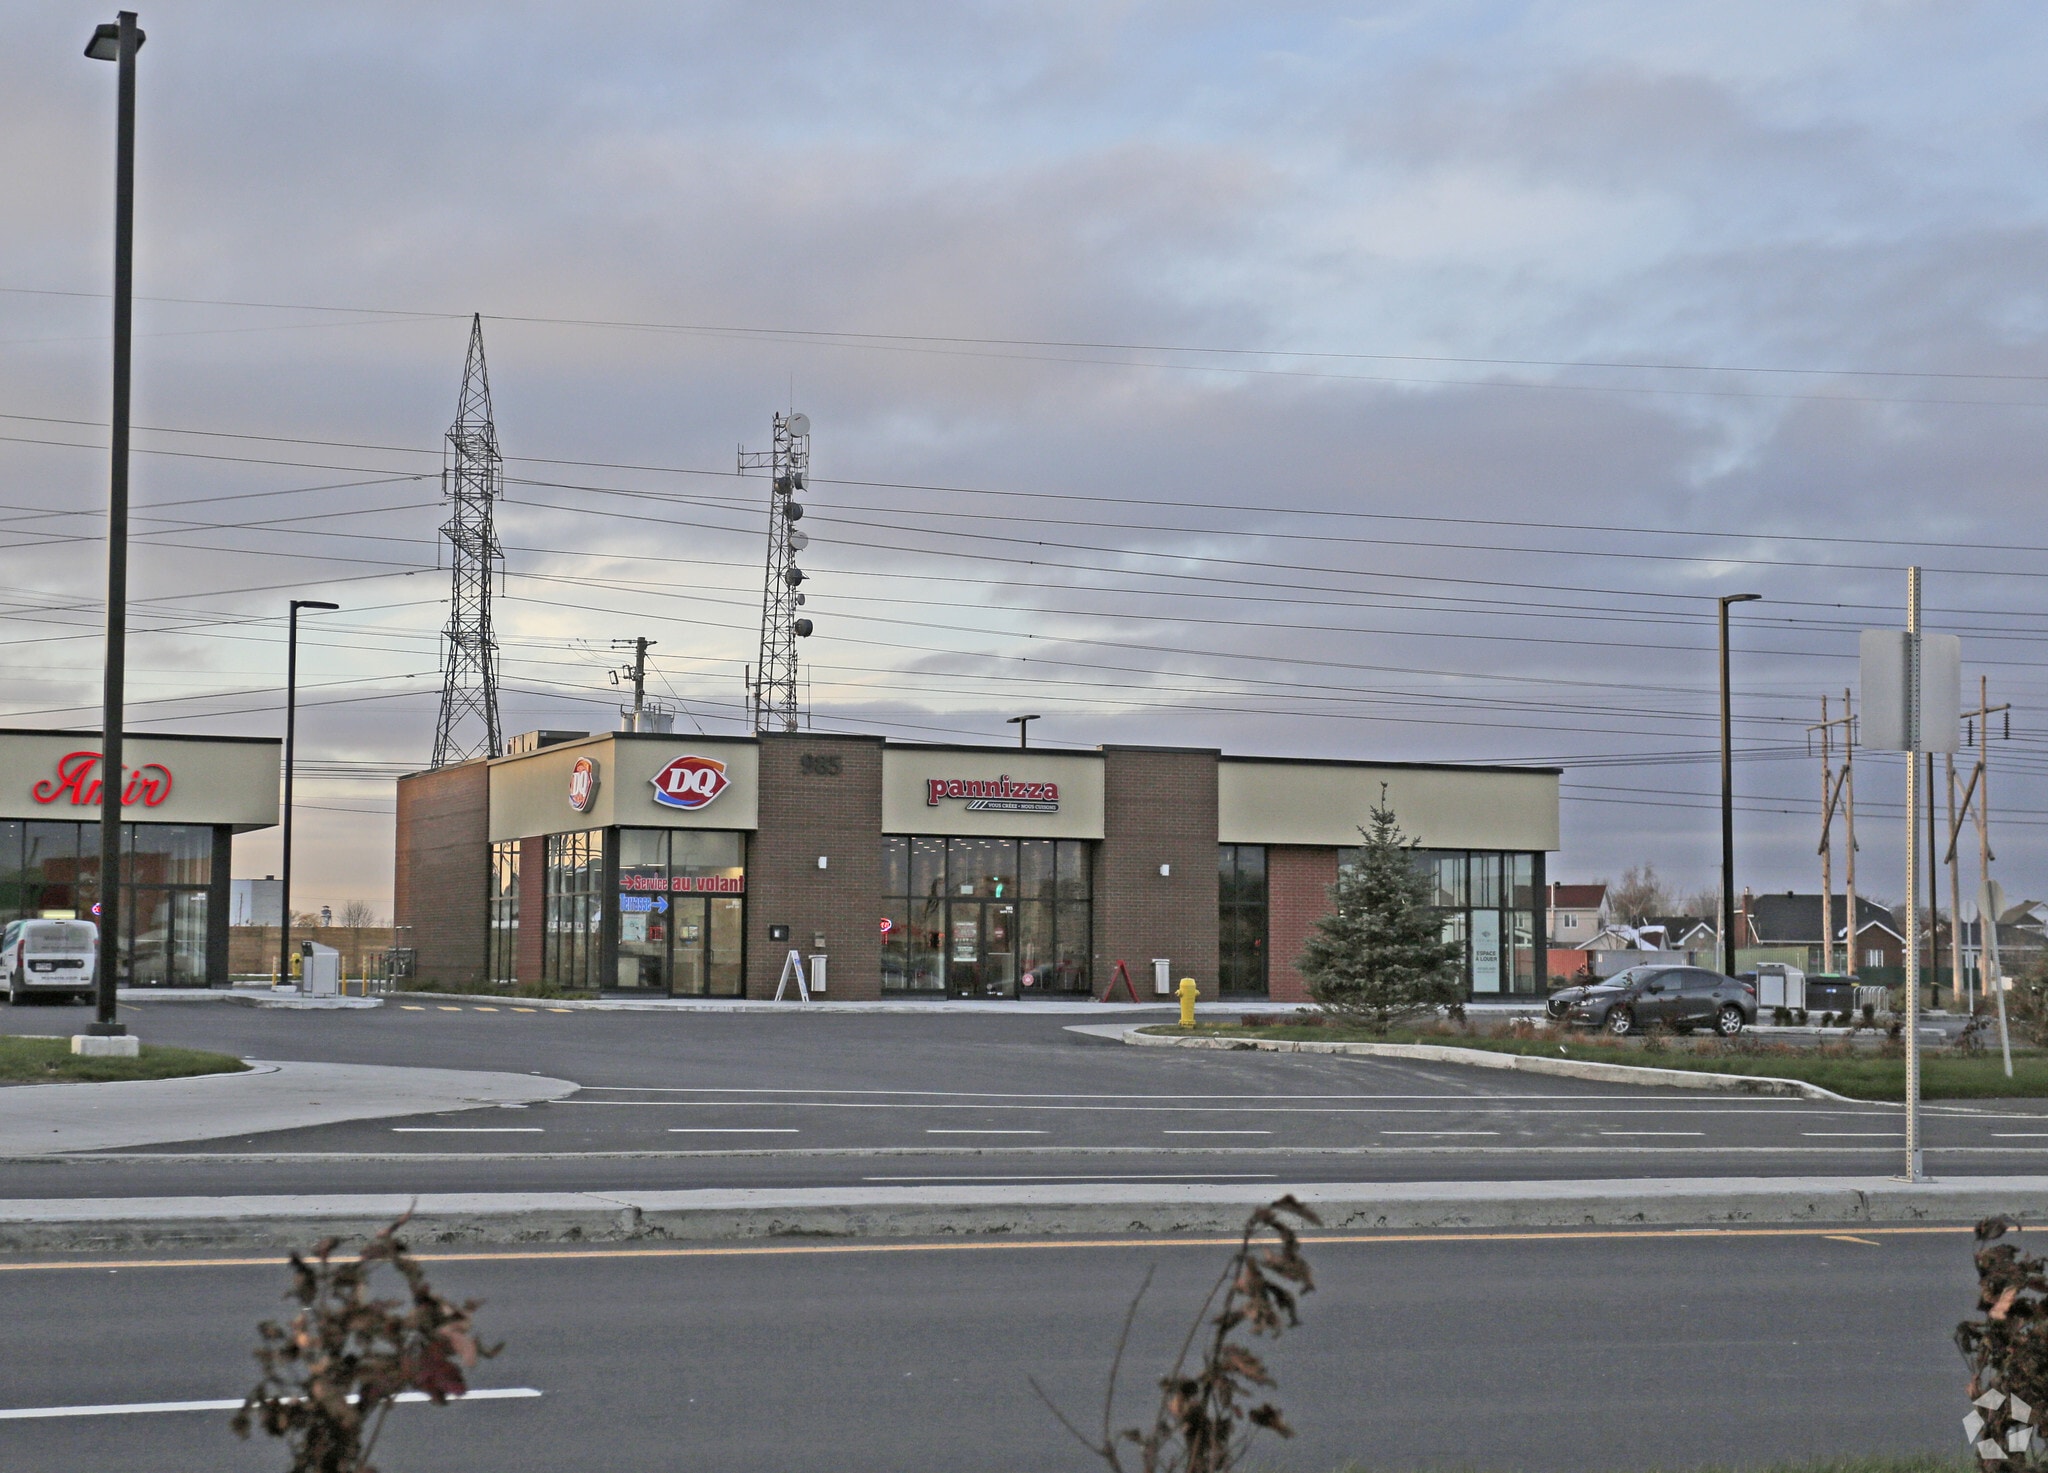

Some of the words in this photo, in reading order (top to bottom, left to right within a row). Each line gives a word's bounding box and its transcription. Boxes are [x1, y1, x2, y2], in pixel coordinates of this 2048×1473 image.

[572, 770, 588, 797] DQ
[666, 768, 717, 797] DQ
[929, 774, 1059, 806] pannizza
[634, 875, 668, 890] Service
[672, 876, 691, 892] au
[696, 874, 745, 892] volant
